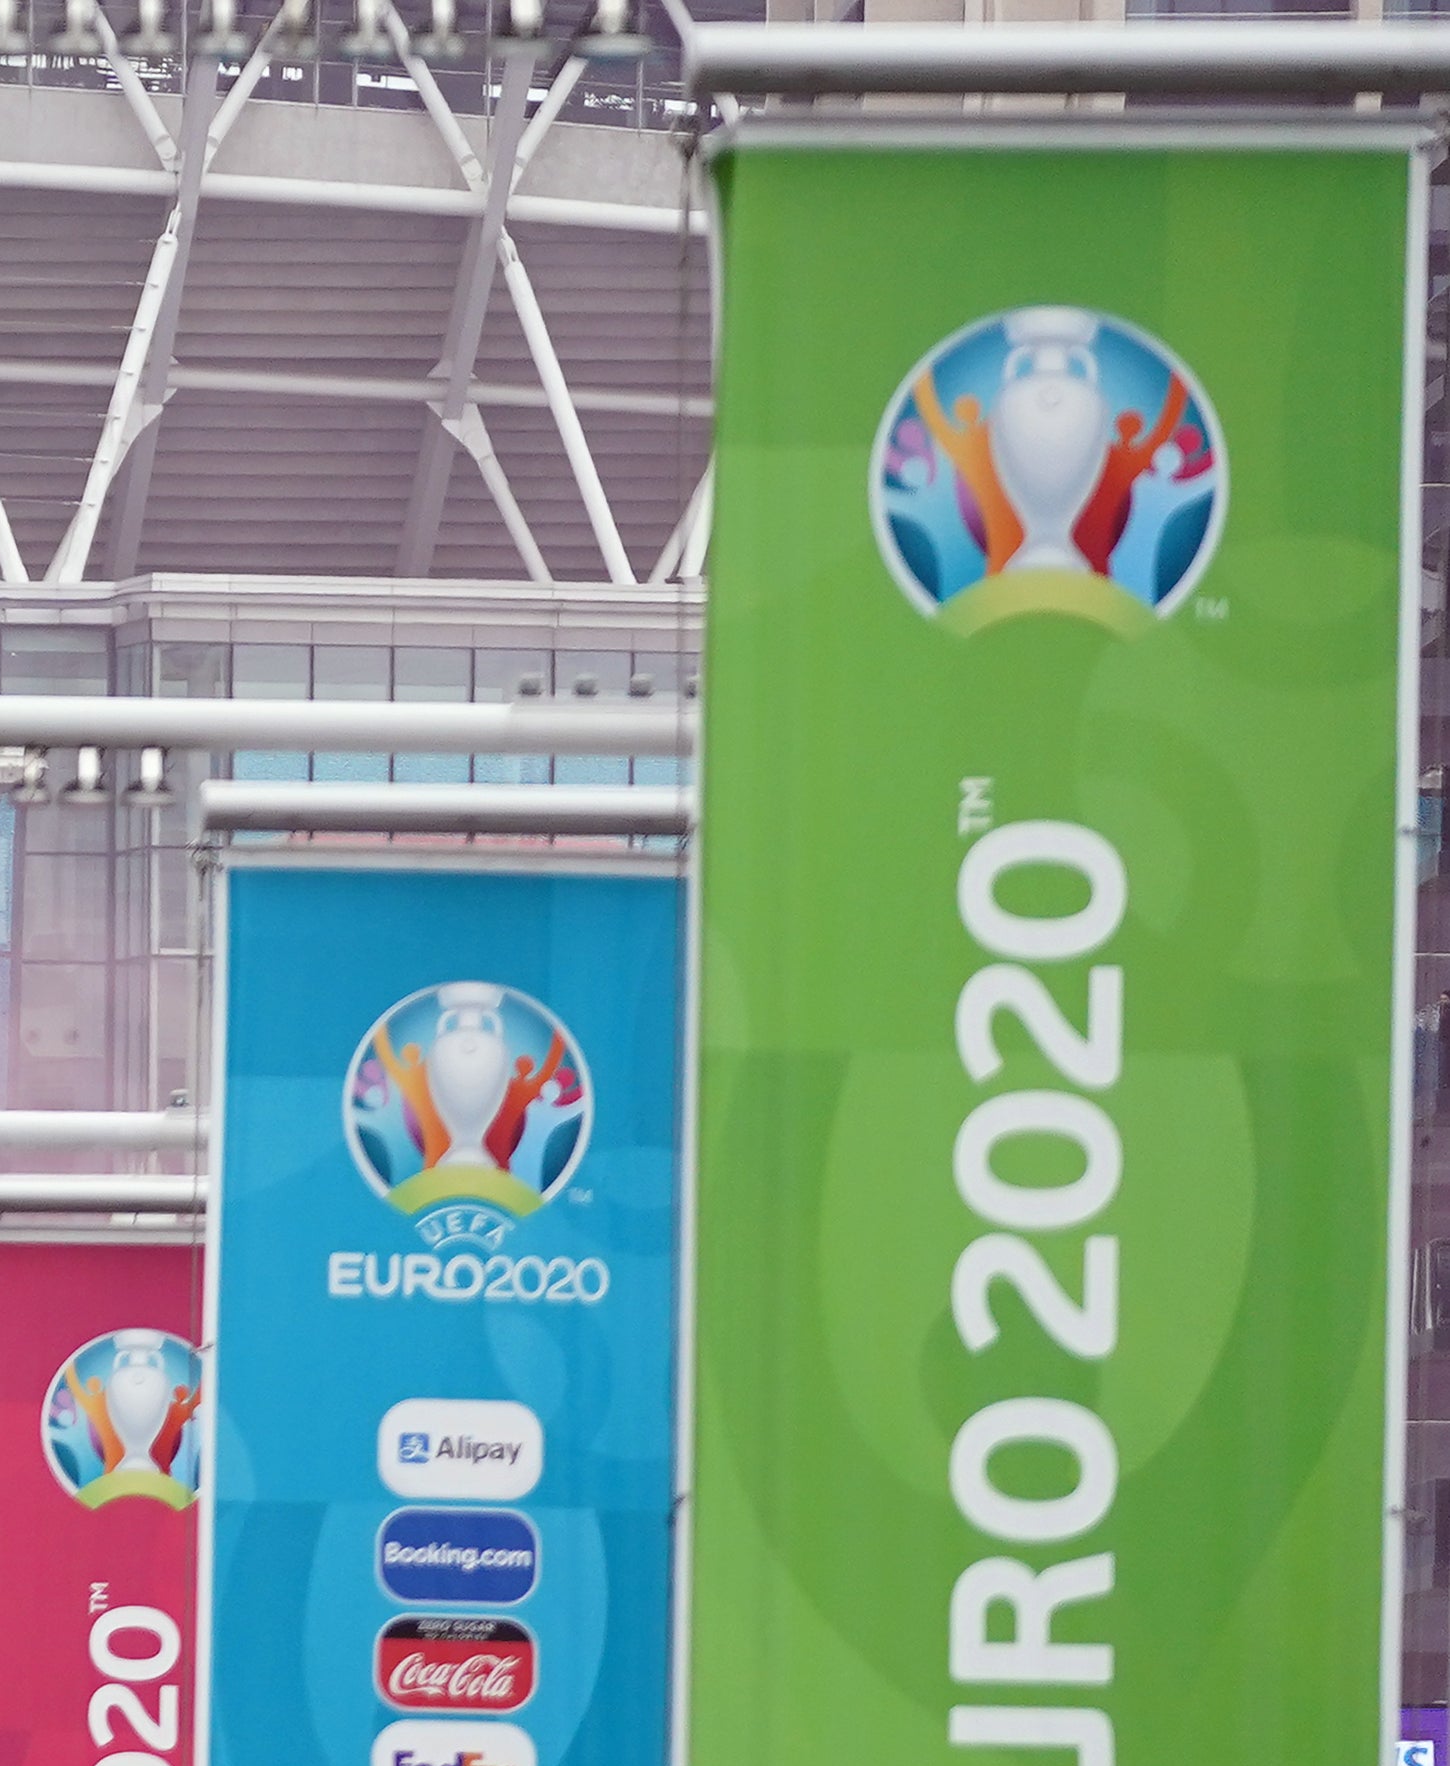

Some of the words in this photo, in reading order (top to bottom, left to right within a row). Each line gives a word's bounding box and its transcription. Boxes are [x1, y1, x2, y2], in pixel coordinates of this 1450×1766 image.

[949, 818, 1127, 1357] 2020
[421, 1213, 505, 1250] UEFA
[328, 1252, 610, 1302] EURO2020
[436, 1435, 521, 1466] Alipay
[383, 1541, 532, 1571] Booking.com
